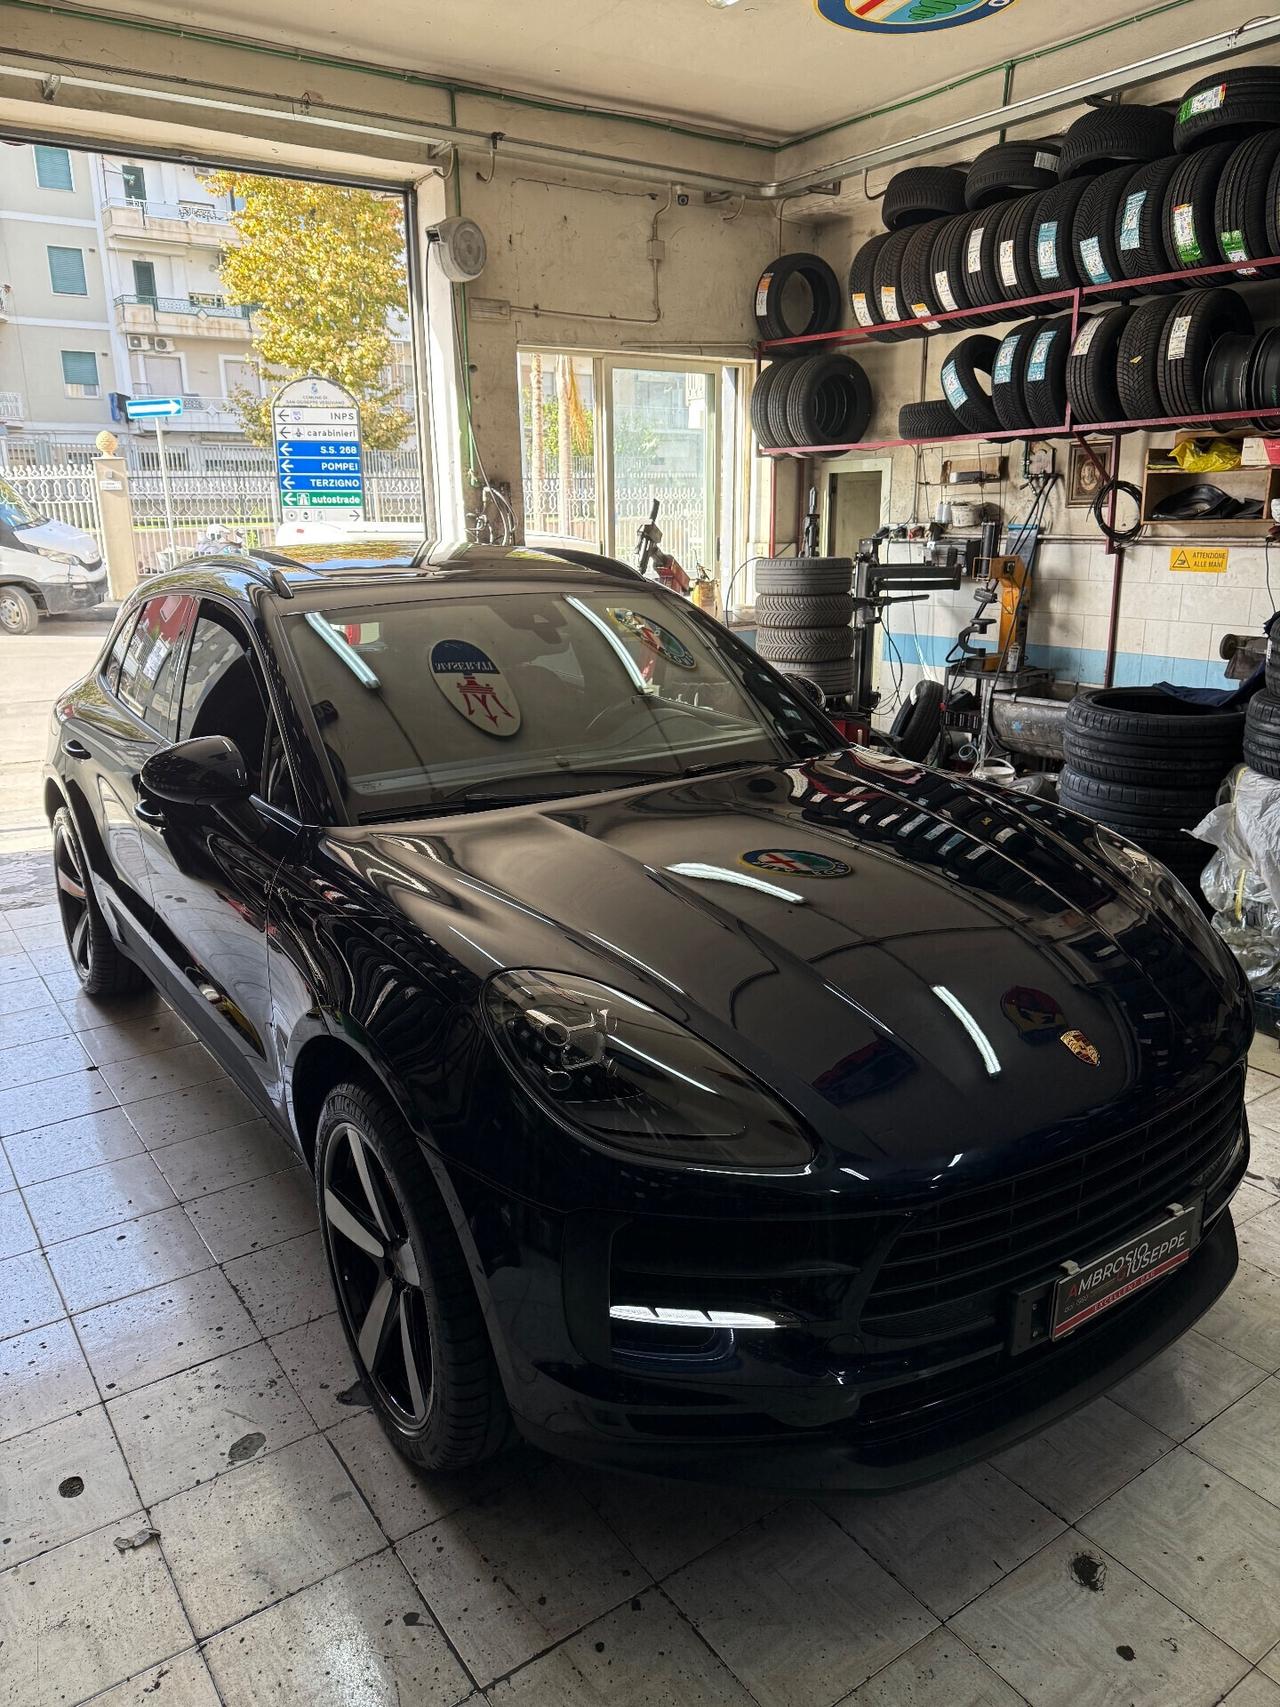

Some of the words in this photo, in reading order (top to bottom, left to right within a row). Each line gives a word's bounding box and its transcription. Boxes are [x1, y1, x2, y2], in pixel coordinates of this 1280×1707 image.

[330, 412, 354, 420] INPS
[307, 429, 356, 437] carabinieri
[319, 446, 337, 454] S.S.
[339, 446, 357, 454] 268
[321, 462, 358, 471] POMPEI
[310, 479, 360, 487] TERZIGNO
[311, 495, 360, 504] autostrade
[1193, 560, 1207, 568] ALLE
[1208, 560, 1223, 568] MANI
[1116, 1231, 1187, 1281] GIUSEPPE
[1068, 1242, 1149, 1297] AMBROSIO
